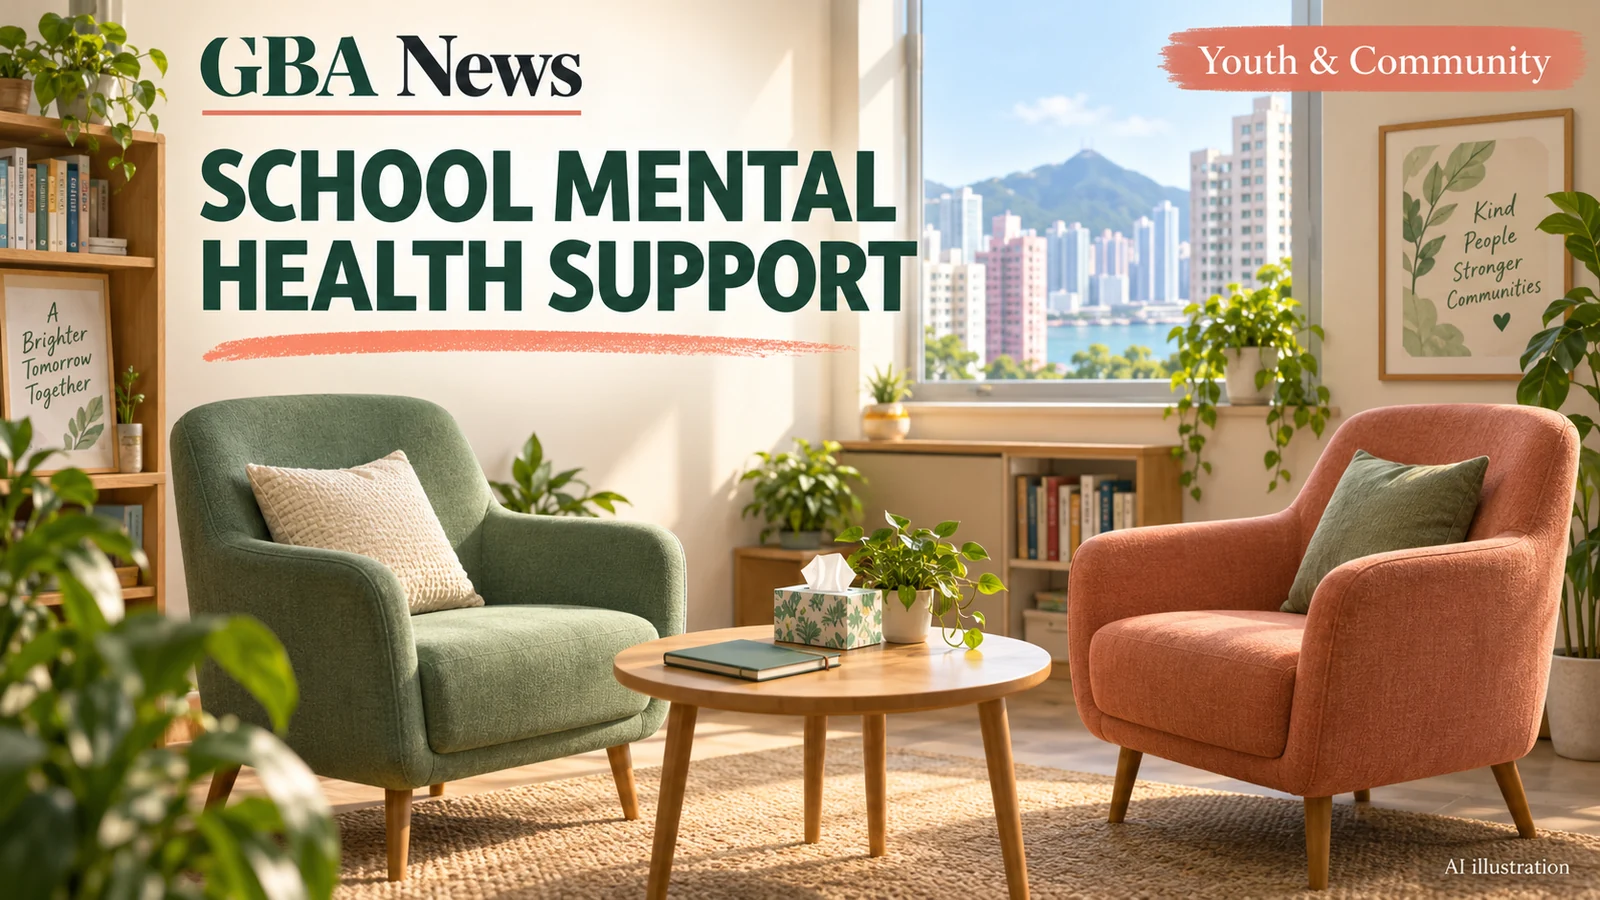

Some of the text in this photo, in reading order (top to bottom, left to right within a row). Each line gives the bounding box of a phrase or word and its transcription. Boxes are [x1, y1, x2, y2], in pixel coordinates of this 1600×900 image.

[1473, 192, 1517, 224] Kind
[1464, 225, 1517, 255] People
[1453, 257, 1523, 283] Stronger
[1447, 279, 1541, 310] Communities
[47, 302, 58, 323] A
[22, 325, 88, 356] Brighter
[22, 353, 92, 380] Tomorrow
[25, 376, 91, 409] Together
